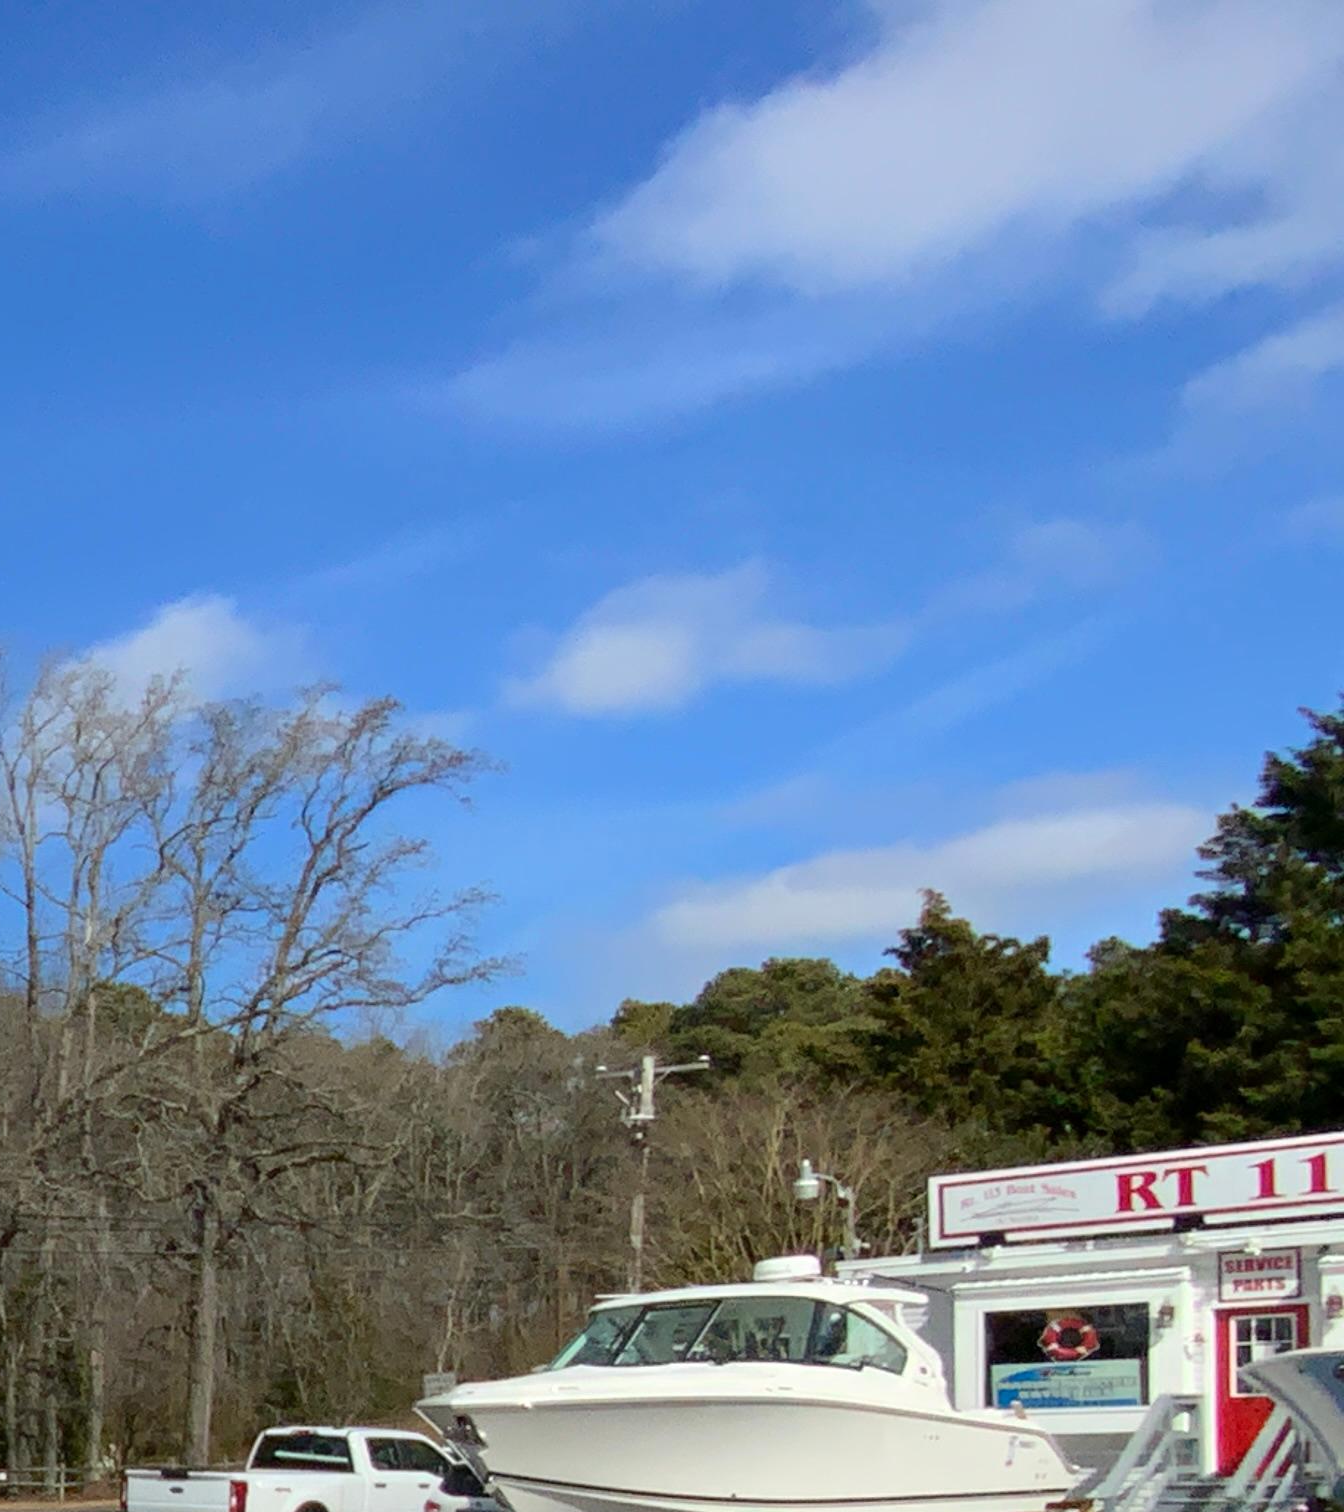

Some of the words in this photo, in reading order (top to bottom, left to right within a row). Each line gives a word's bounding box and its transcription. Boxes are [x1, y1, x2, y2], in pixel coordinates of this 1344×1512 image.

[1007, 1184, 1035, 1196] Boat
[1041, 1184, 1077, 1199] Sales
[1115, 1165, 1209, 1214] RT
[1224, 1255, 1294, 1274] SERVICE
[1232, 1276, 1286, 1293] PARTS
